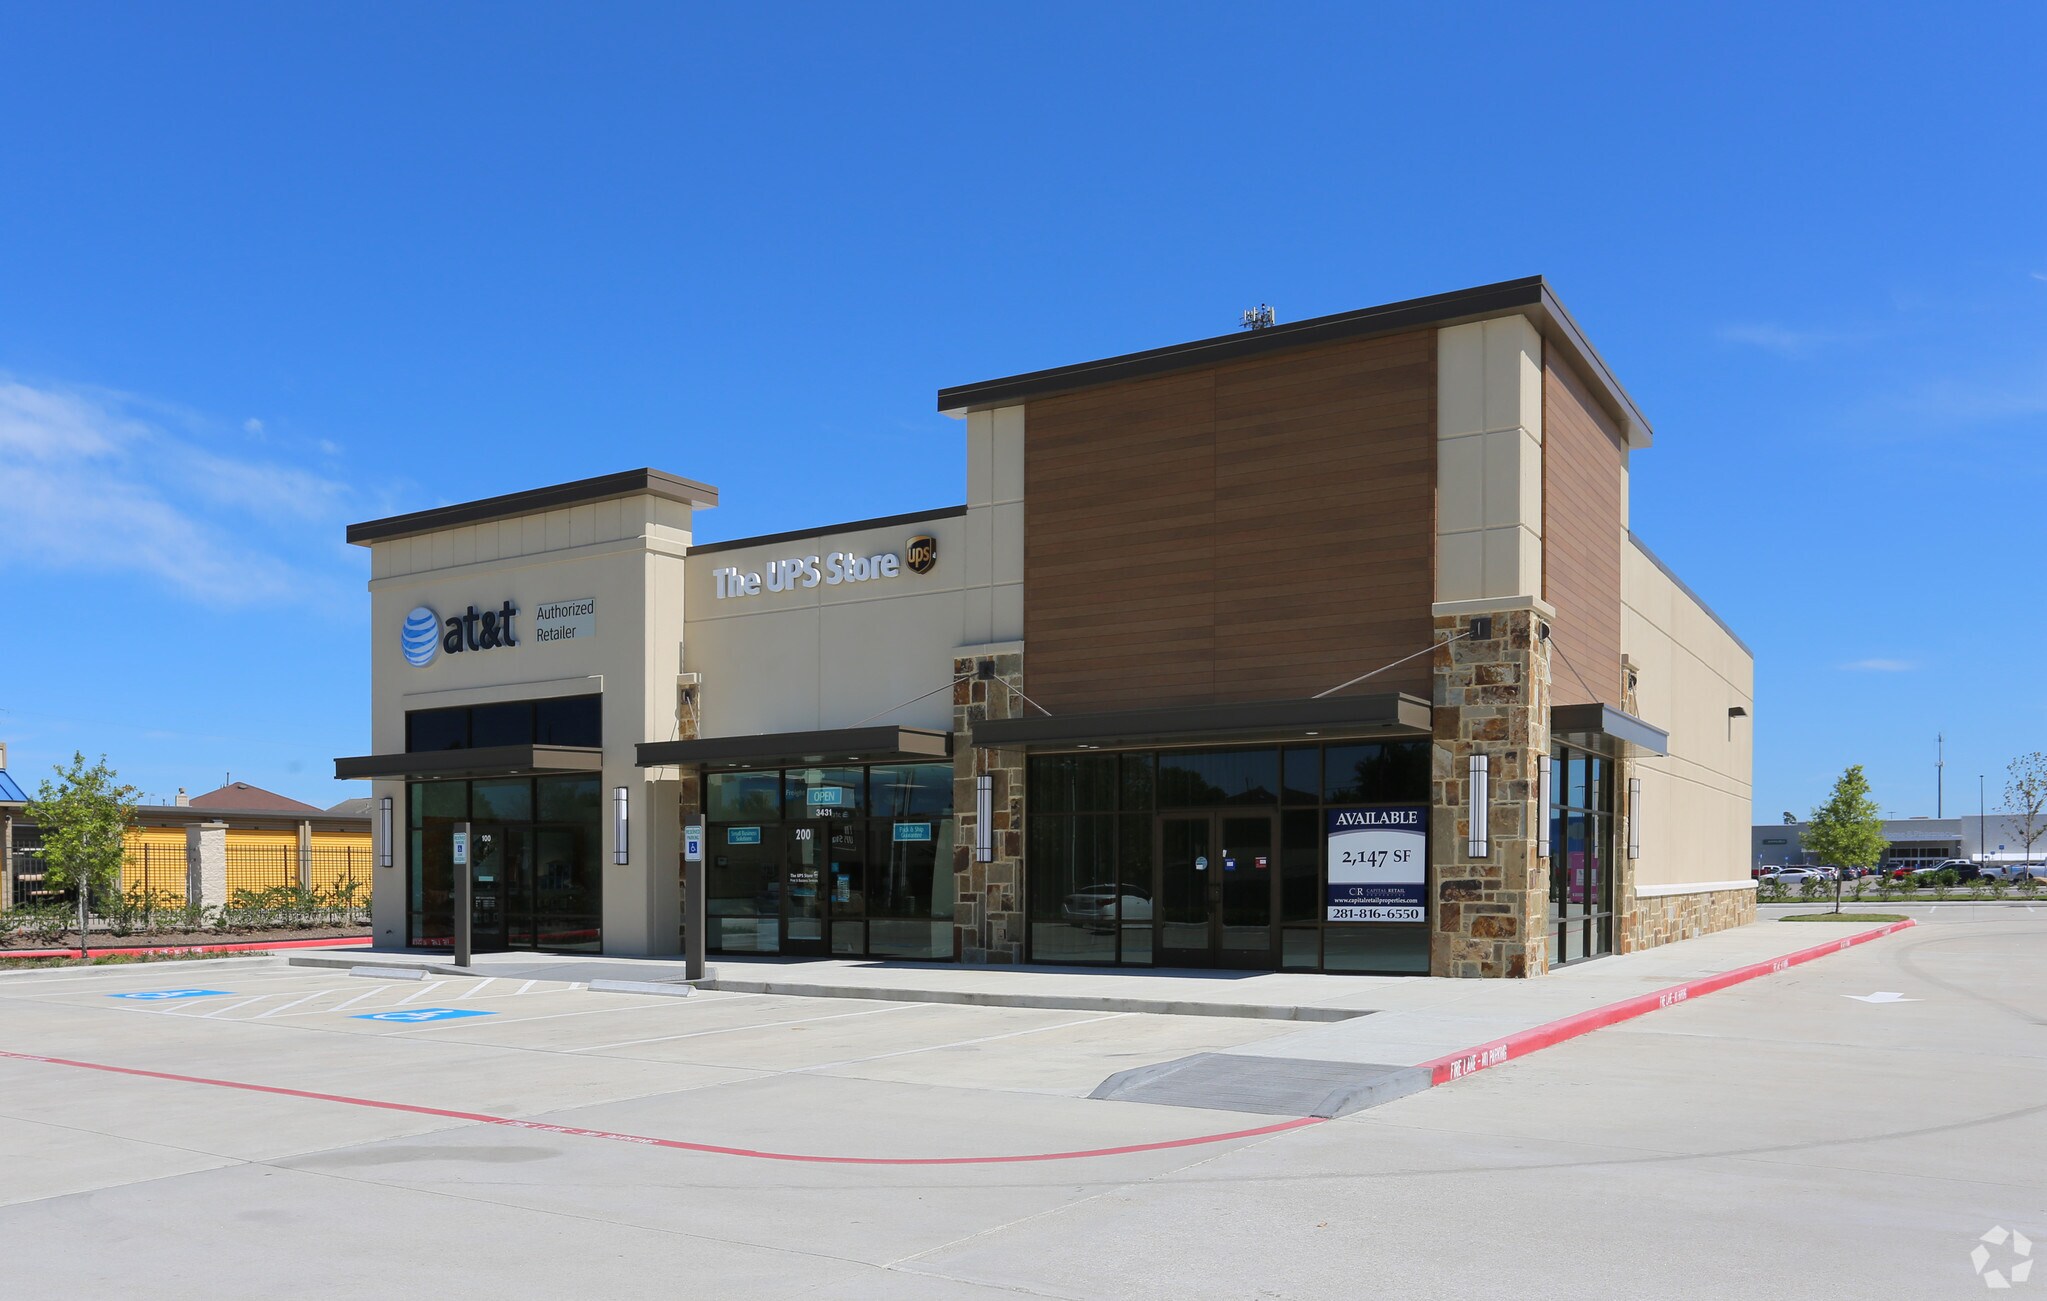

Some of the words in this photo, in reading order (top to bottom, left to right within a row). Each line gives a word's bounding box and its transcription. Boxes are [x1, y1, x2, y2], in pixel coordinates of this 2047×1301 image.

[908, 546, 930, 568] ups
[713, 567, 762, 599] The
[766, 555, 821, 593] UPS
[826, 552, 900, 585] Store
[536, 599, 594, 621] Authorized
[443, 600, 518, 654] at&t
[536, 626, 576, 642] Retailer
[813, 791, 835, 802] OPEN
[815, 808, 832, 817] 3431
[1336, 811, 1418, 826] AVAILABLE
[481, 834, 492, 842] 100
[795, 828, 811, 840] 200
[1342, 850, 1388, 868] 2,147
[1393, 849, 1411, 863] SF
[1333, 908, 1419, 919] 281-816-6550
